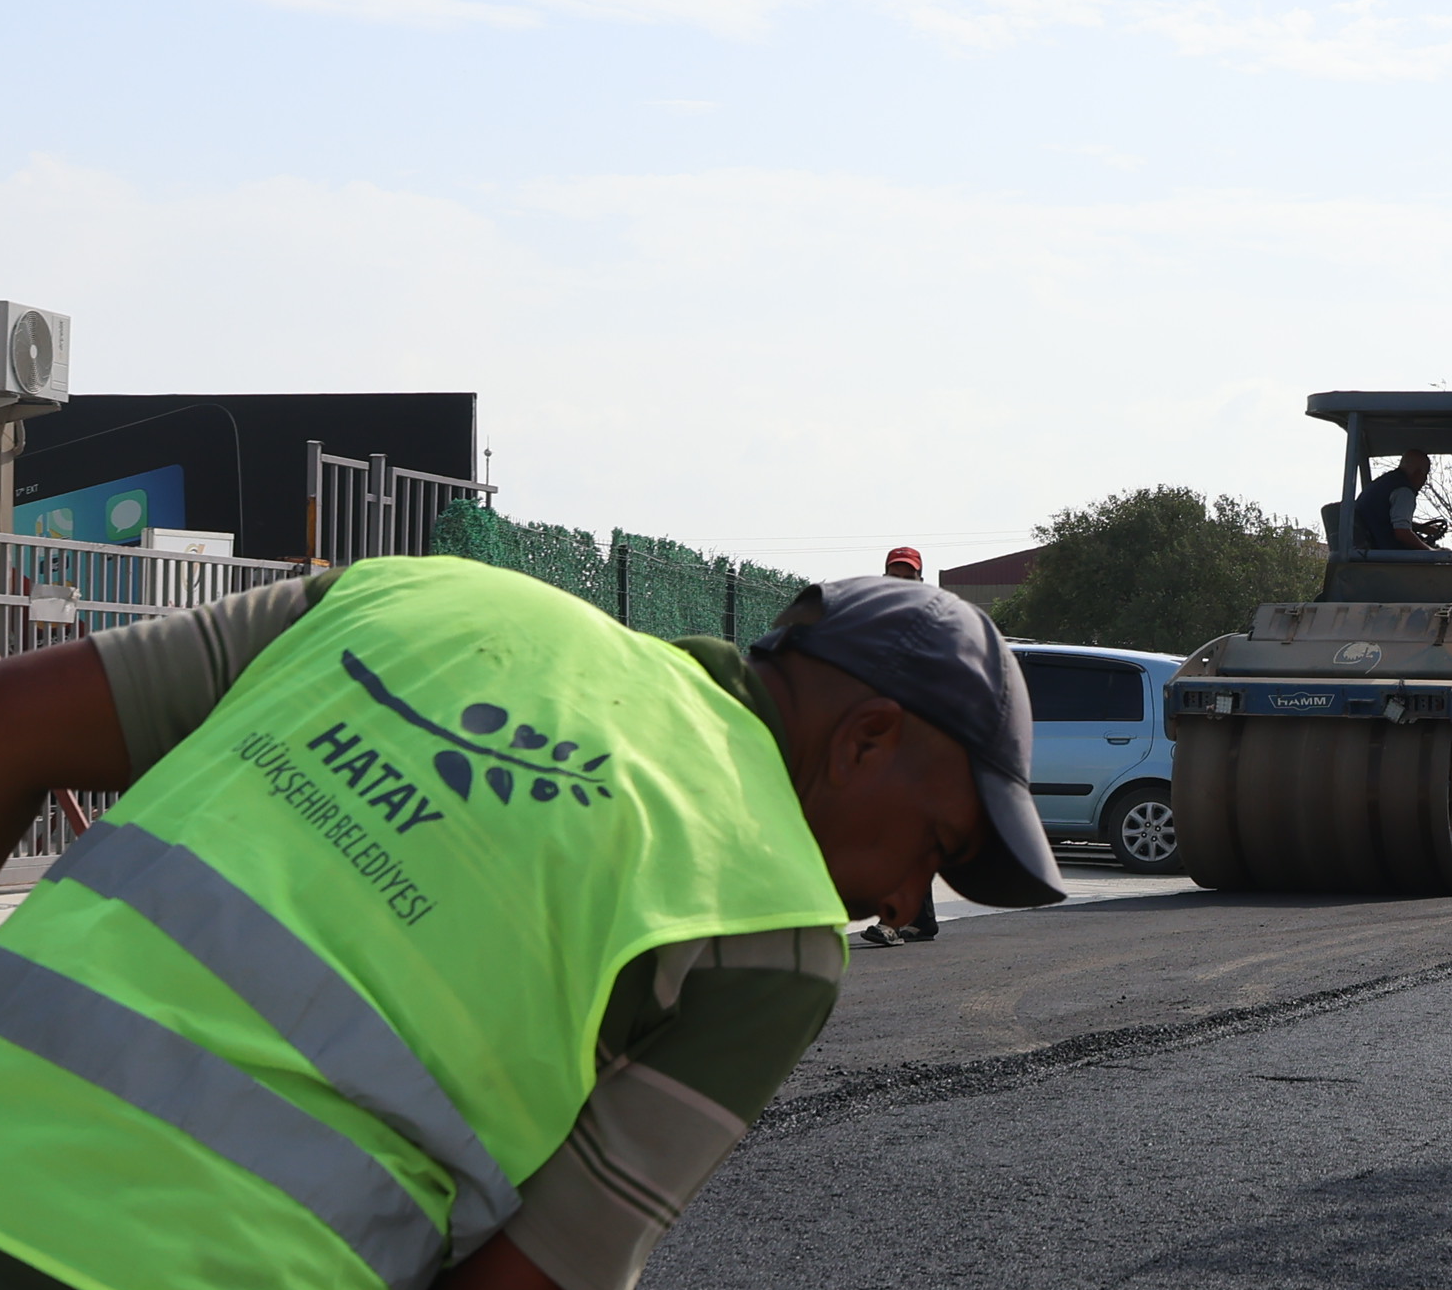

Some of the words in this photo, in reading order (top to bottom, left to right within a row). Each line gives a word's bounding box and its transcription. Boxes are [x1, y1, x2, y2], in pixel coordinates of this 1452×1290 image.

[1277, 696, 1327, 706] HAMM
[306, 722, 445, 835] HATAY
[324, 814, 438, 927] BELEDİYESİ
